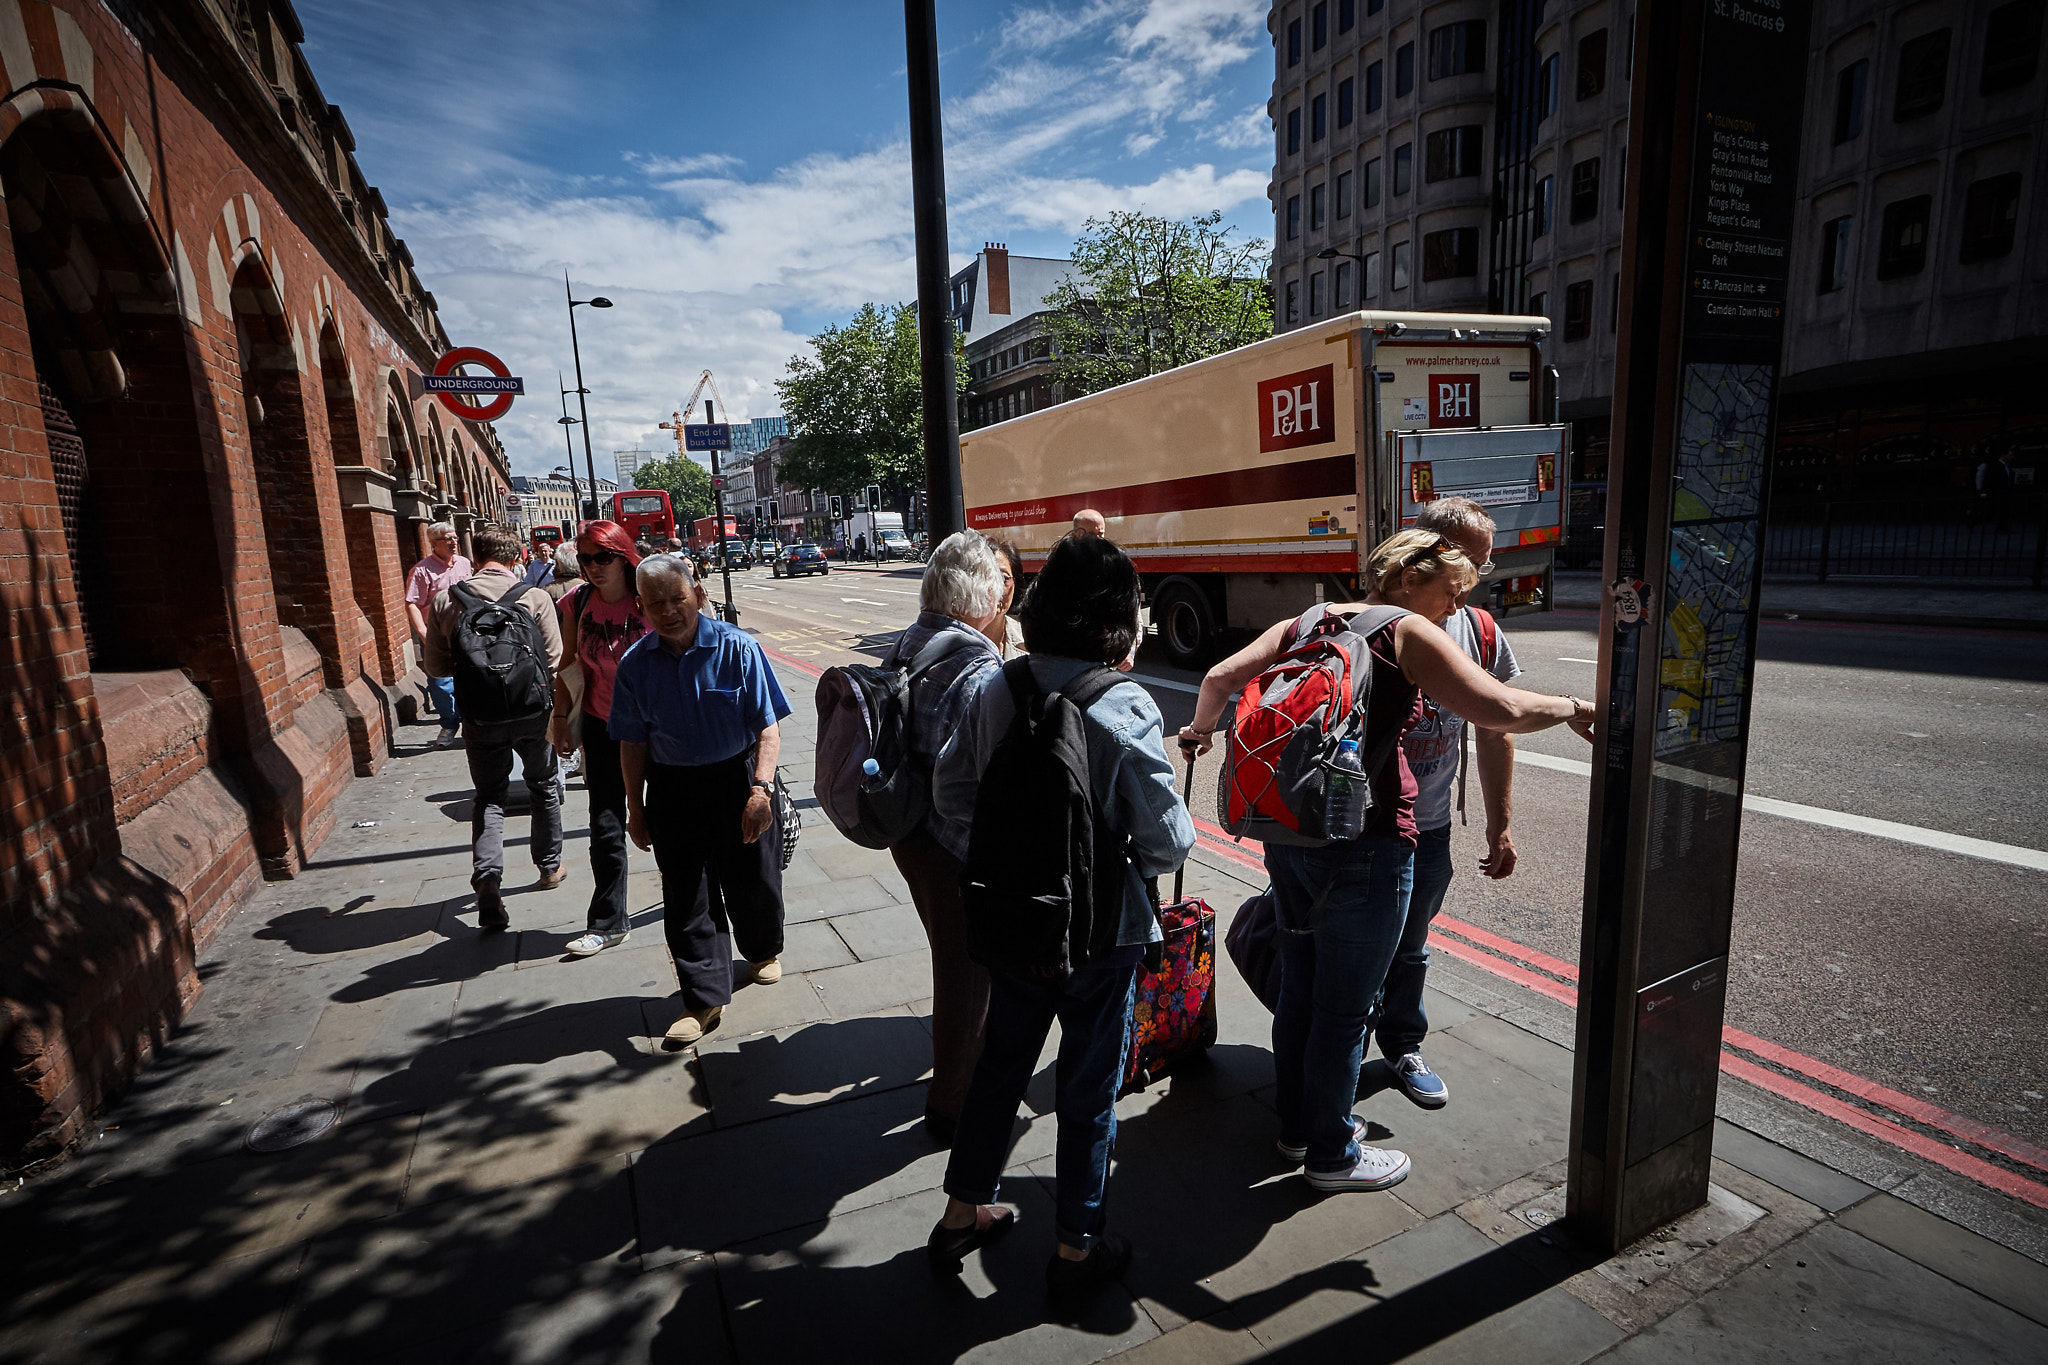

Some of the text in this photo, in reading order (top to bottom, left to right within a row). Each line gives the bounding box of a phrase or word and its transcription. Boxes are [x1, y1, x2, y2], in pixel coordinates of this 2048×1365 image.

[1713, 0, 1774, 31] St. Pancras
[1714, 115, 1756, 133] ISLINGTON
[1713, 131, 1758, 151] King's Cross
[1712, 148, 1769, 168] Gray's Inn Road
[1711, 164, 1773, 185] Pentonville Road
[1710, 180, 1745, 198] York Way
[1708, 196, 1750, 212] Kings Place
[1707, 212, 1761, 229] Regent's Canal
[1705, 238, 1784, 257] Camley Street Natural
[1711, 254, 1728, 266] Park
[1702, 278, 1756, 294] St. Pancras Int.
[1707, 303, 1773, 318] Camden Town Hall
[1405, 355, 1501, 368] www.palmerharvey.co.uk
[429, 379, 518, 390] UNDERGROUND
[1270, 381, 1320, 437] P&H
[1438, 383, 1471, 418] P&H
[693, 428, 722, 437] End of
[690, 438, 727, 446] bus lane
[975, 514, 988, 522] Always
[988, 511, 1008, 520] Delivering
[1622, 590, 1638, 615] 1884
[764, 626, 844, 641] BUS
